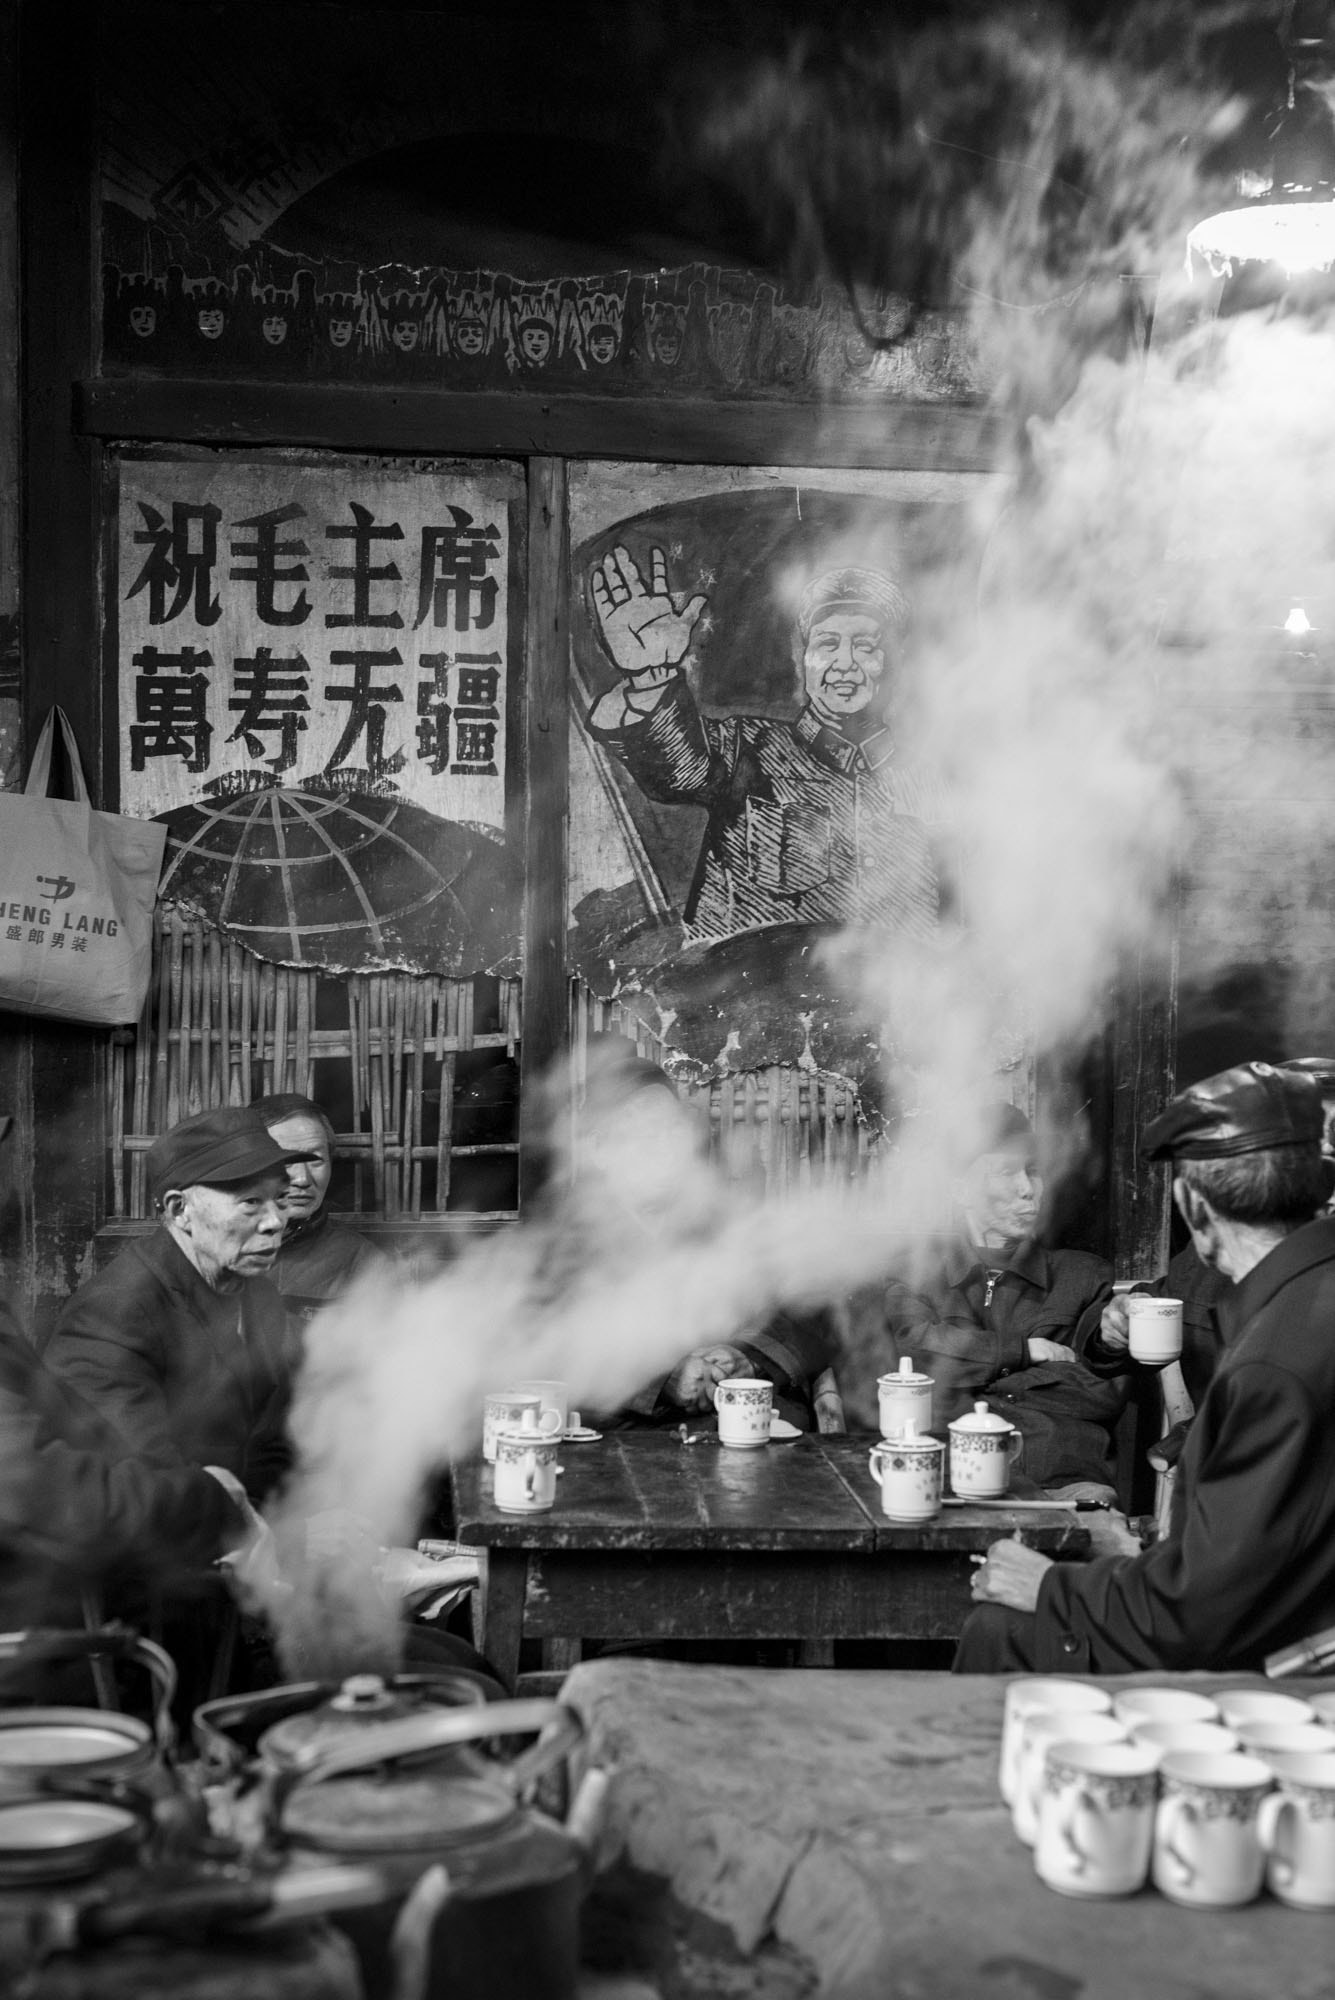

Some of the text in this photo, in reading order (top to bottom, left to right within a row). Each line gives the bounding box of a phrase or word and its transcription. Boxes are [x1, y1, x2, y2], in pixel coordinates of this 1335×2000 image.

[125, 501, 501, 632] 祝毛主席
[129, 646, 502, 776] 萬寿无疆
[5, 925, 89, 953] 盛郎男装
[63, 912, 118, 937] LANG
